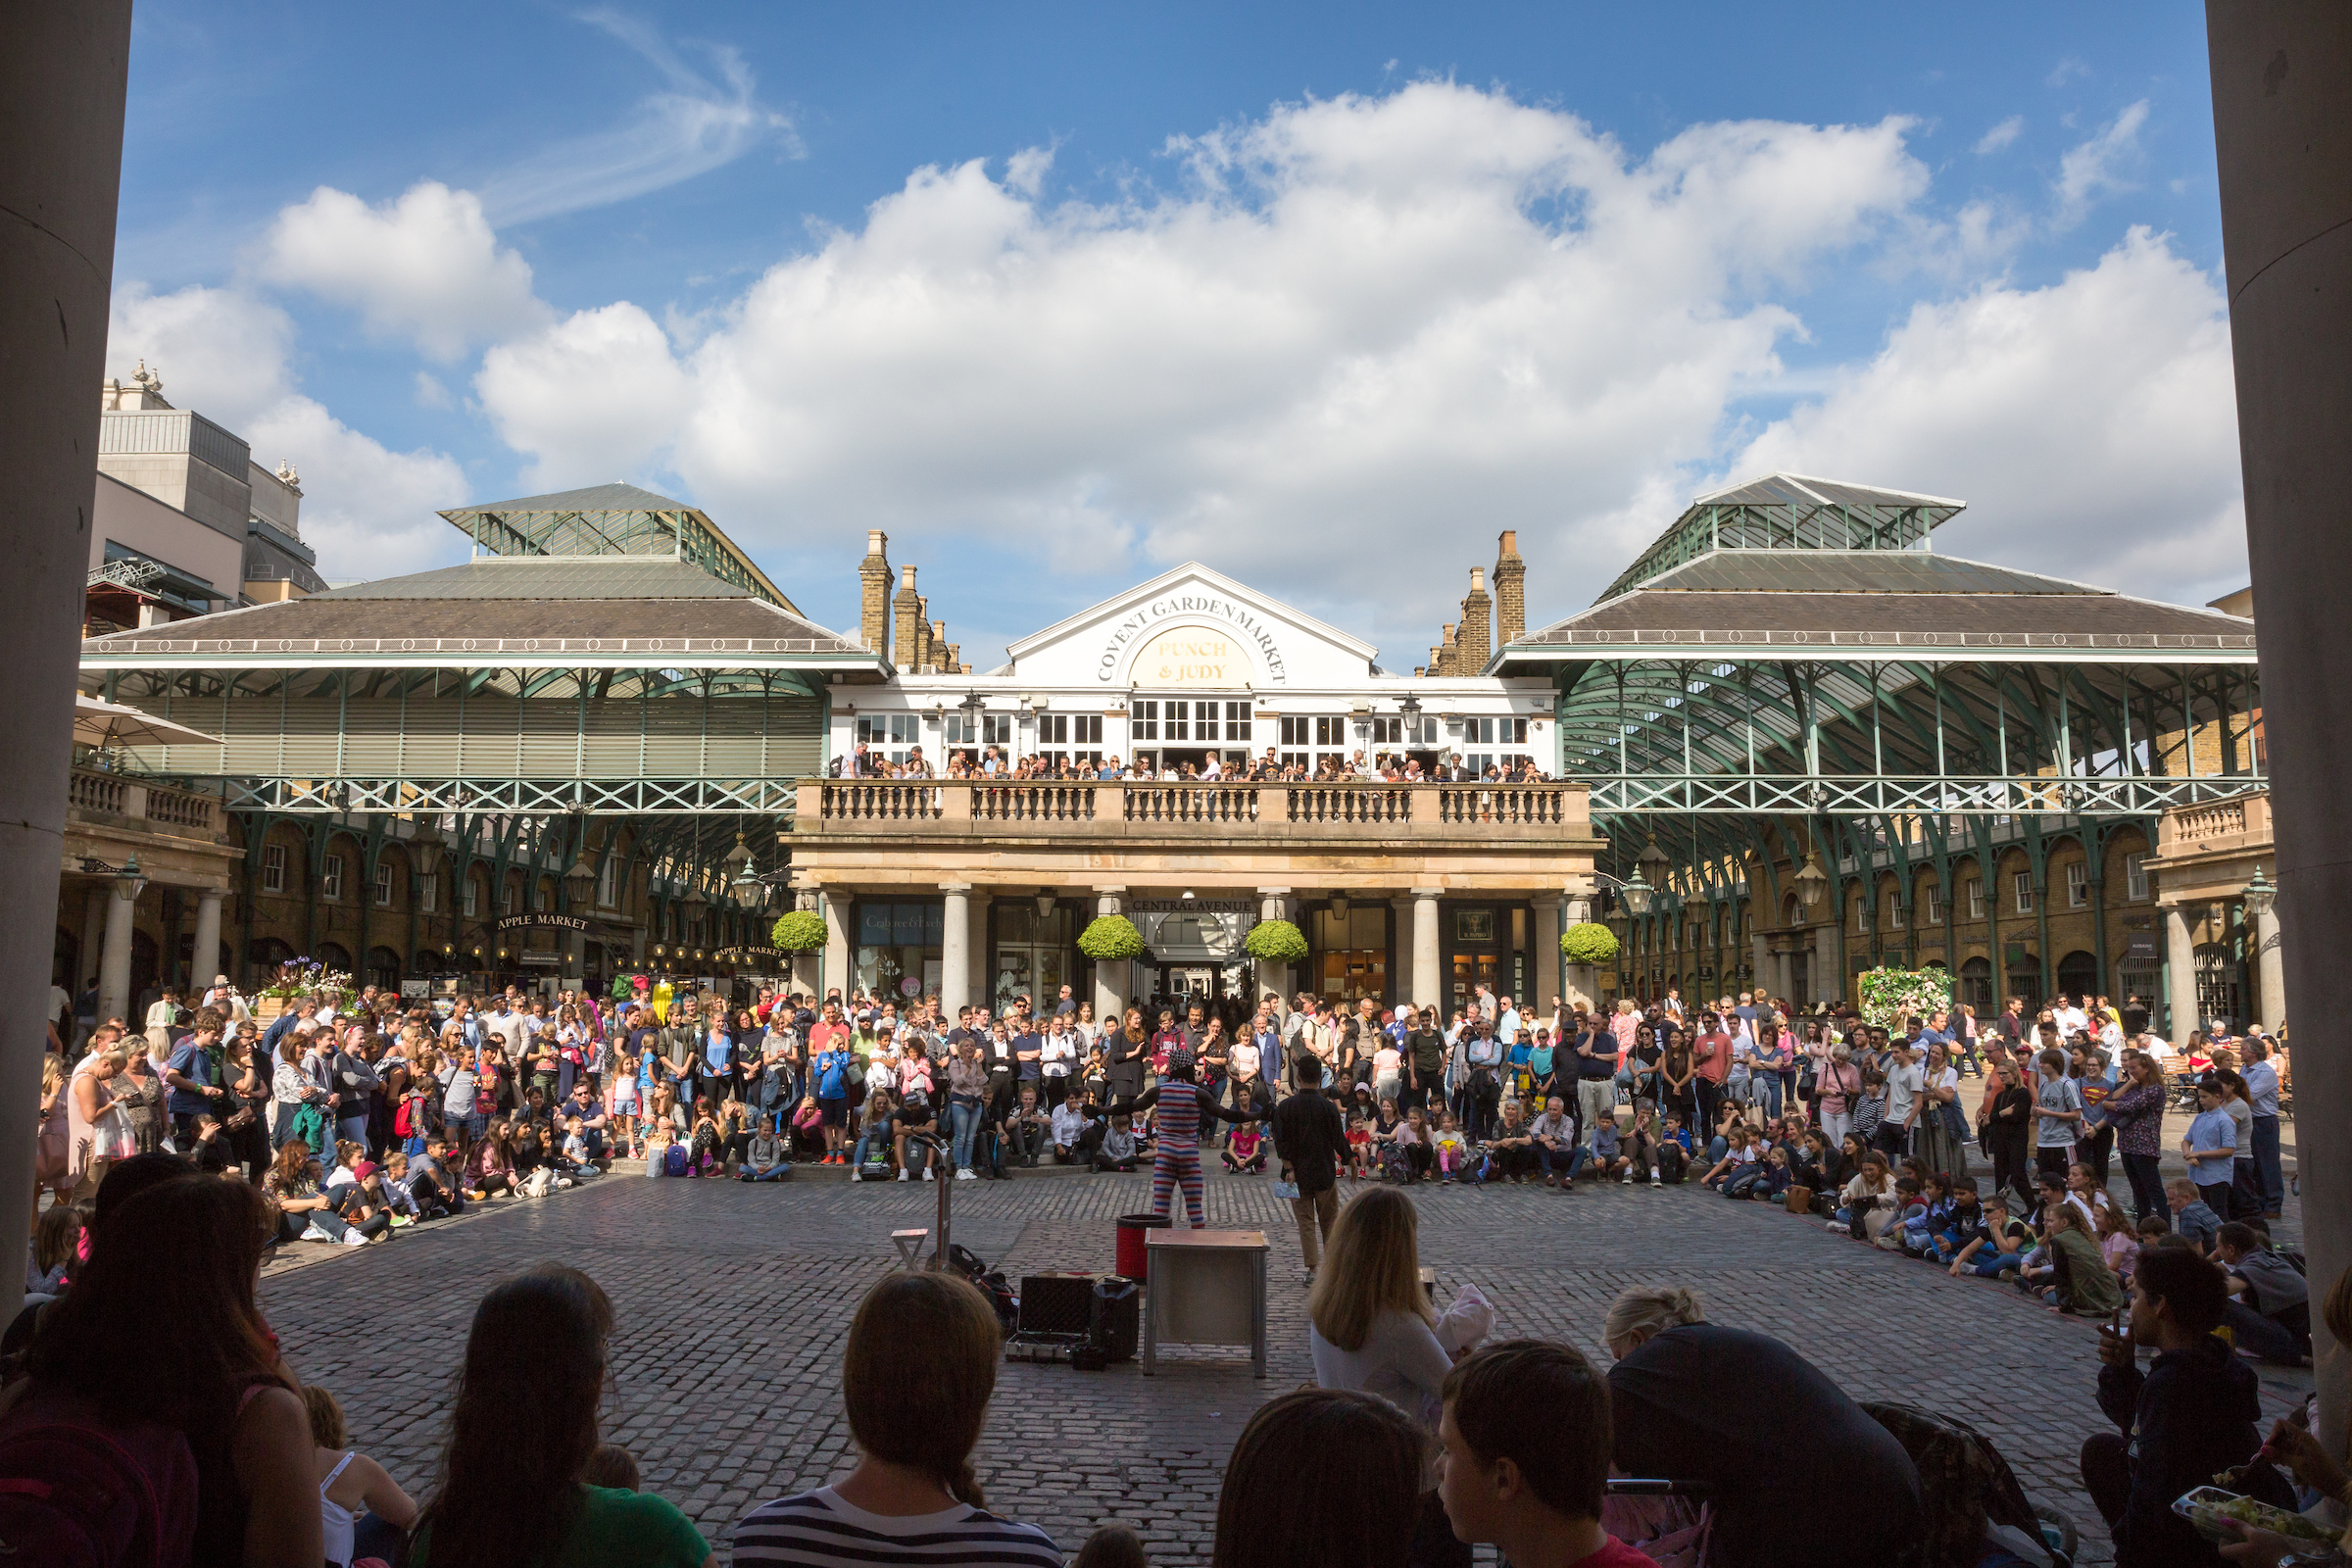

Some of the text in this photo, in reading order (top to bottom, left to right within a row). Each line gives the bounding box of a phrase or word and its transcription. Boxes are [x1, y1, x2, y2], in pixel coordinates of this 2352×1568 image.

[1099, 597, 1286, 684] COVENT GARDEN MARKET
[1158, 642, 1226, 657] PUNCH
[1158, 664, 1226, 682] & JUDY
[1133, 901, 1251, 911] CENTRAL AVENUE
[498, 914, 588, 930] APPLE MARKET
[866, 914, 908, 929] Crabree
[720, 946, 783, 957] APPLE MARKET
